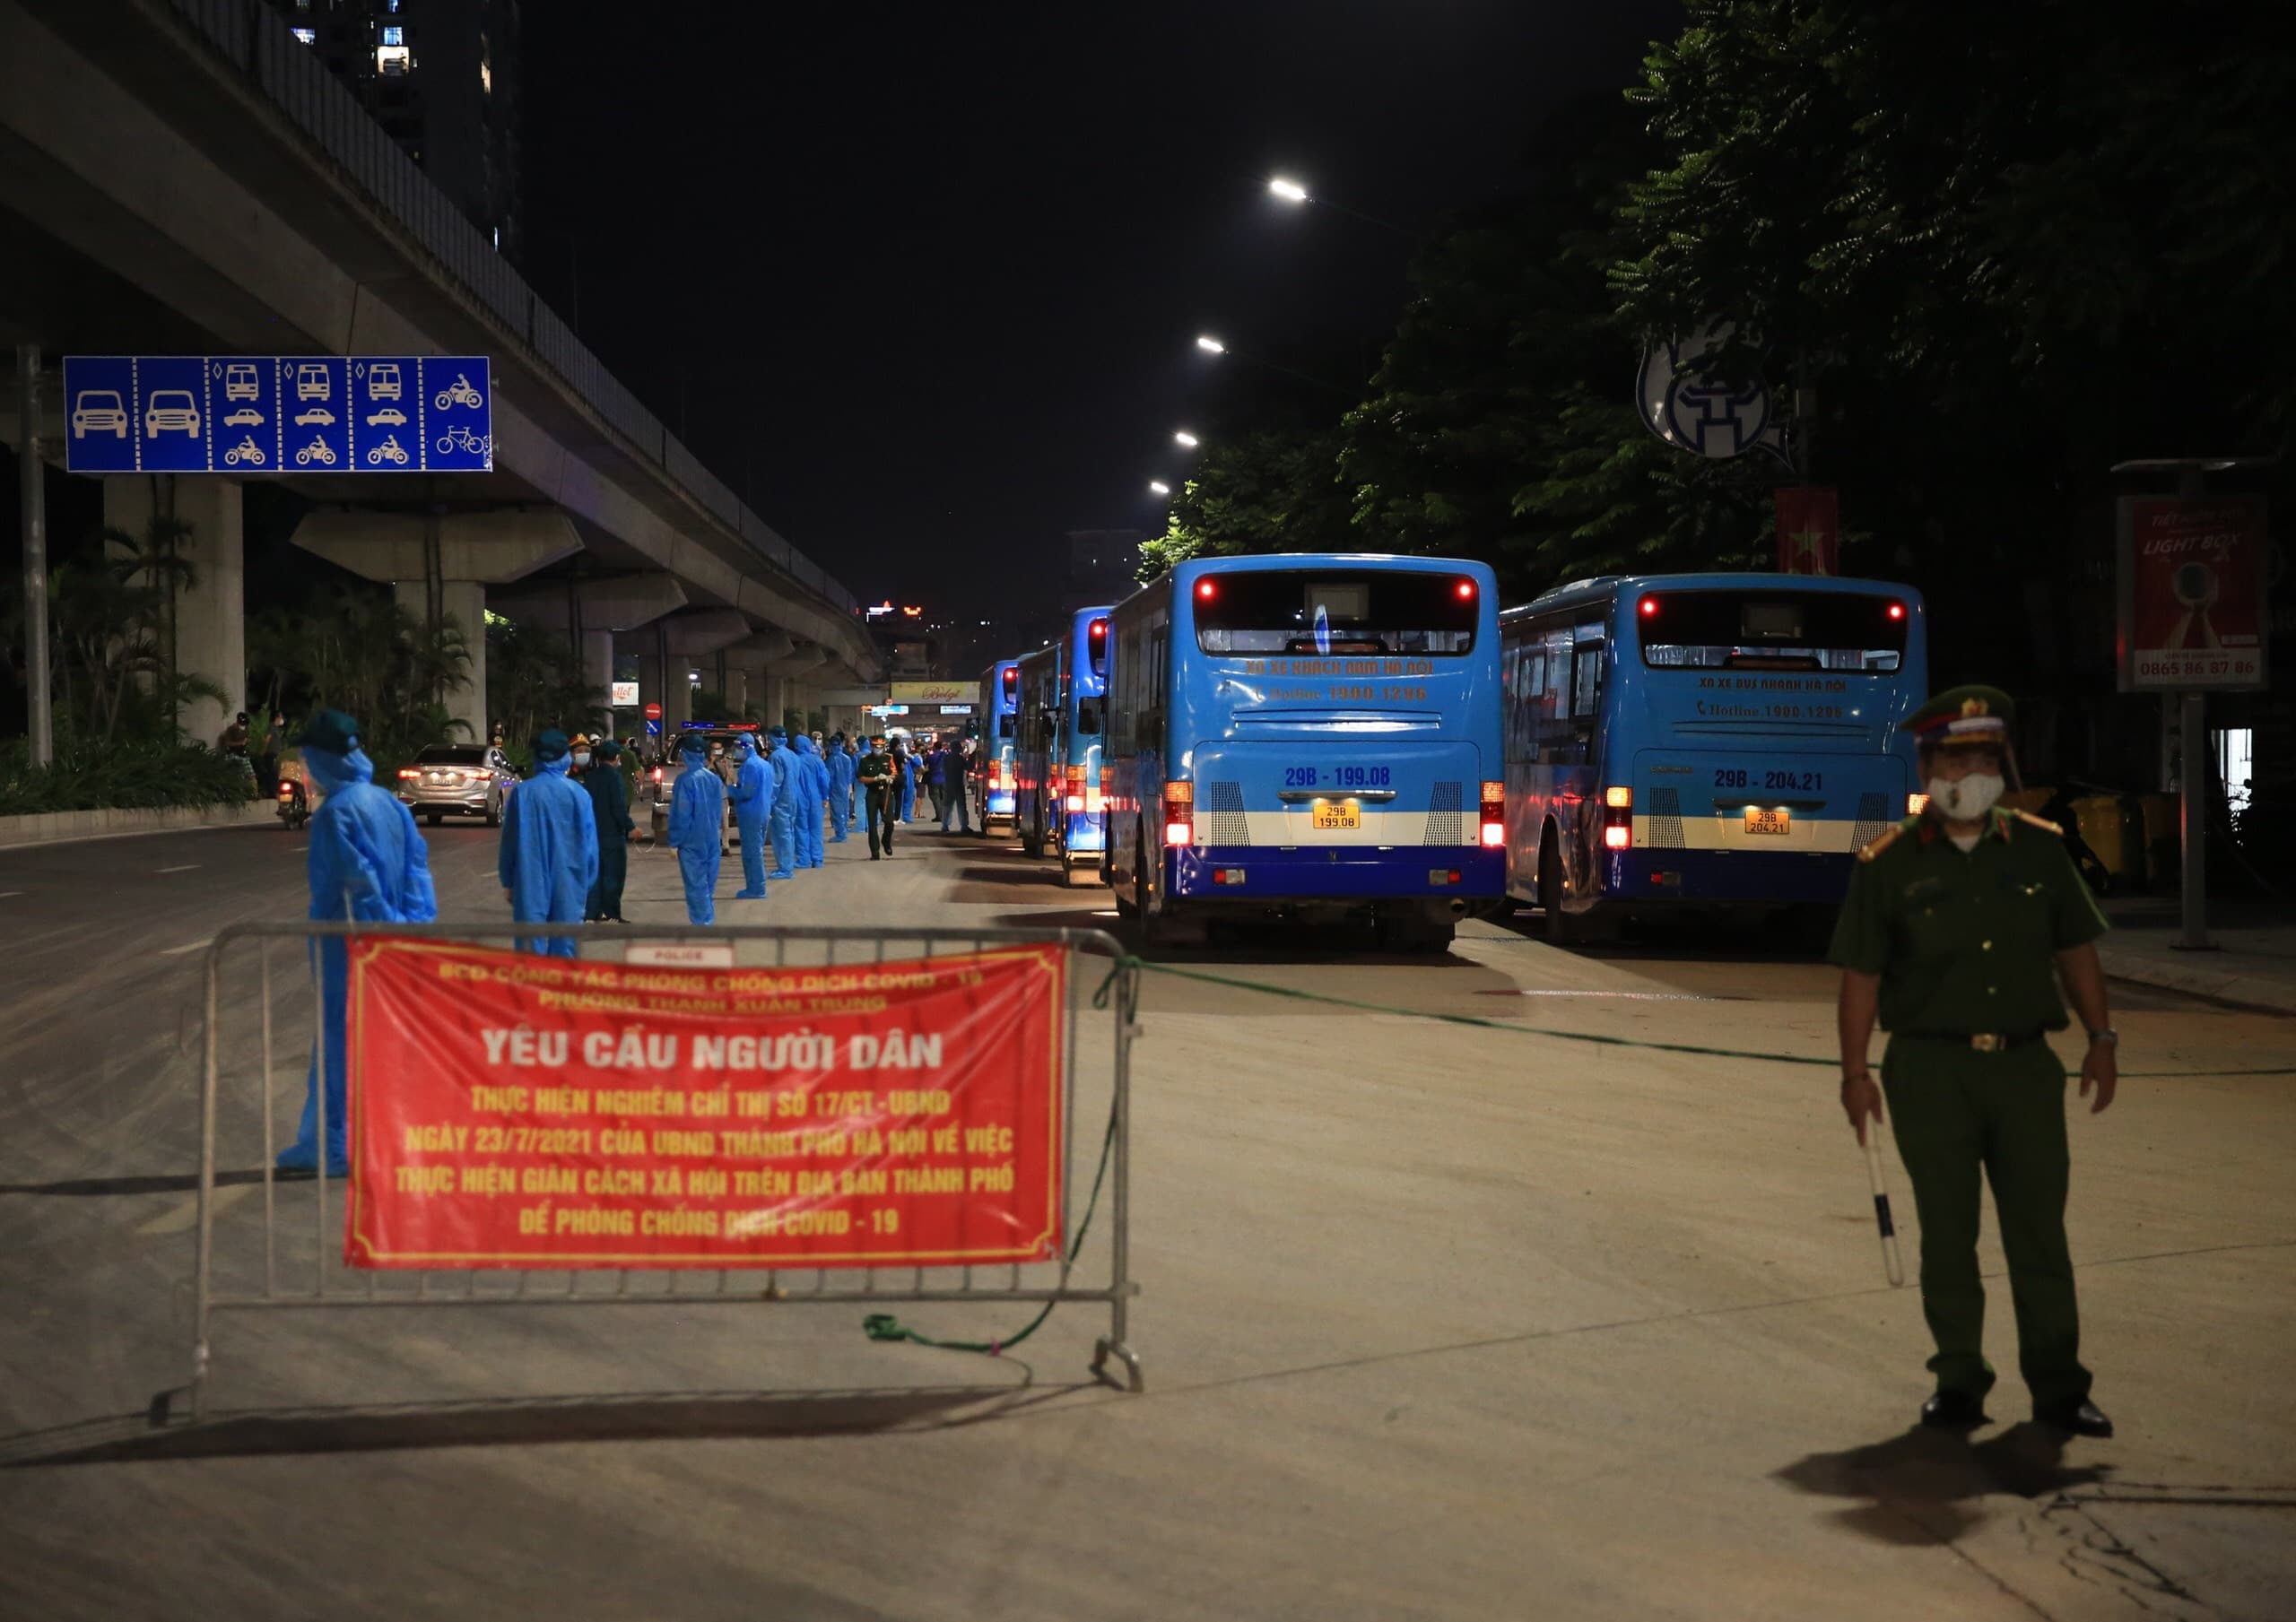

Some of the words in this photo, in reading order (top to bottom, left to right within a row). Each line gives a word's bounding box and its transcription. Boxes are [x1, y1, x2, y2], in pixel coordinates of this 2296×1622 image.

[2143, 536, 2200, 556] LIGHT
[2200, 532, 2242, 551] BOX
[2141, 662, 2180, 675] 0865
[1285, 768, 1317, 786] 29B
[1335, 767, 1390, 786] 199.08
[1715, 768, 1747, 788] 29B
[1765, 771, 1822, 790] 204.21
[1326, 807, 1346, 816] 29B
[1758, 812, 1777, 822] 29B
[1750, 822, 1783, 833] 204.21
[655, 951, 702, 960] POLICE
[571, 966, 617, 987] TÁC
[863, 972, 935, 991] COVID
[649, 994, 726, 1012] THANH
[808, 995, 887, 1012] TRUNG
[481, 1023, 568, 1067] YÊU
[584, 1023, 676, 1069] CẦU
[691, 1028, 835, 1070] NGƯỜI
[849, 1028, 943, 1070] DÂN
[472, 1085, 528, 1117] THỰC
[535, 1085, 588, 1118] HIỆN
[405, 1121, 467, 1151] NGÀY
[474, 1126, 591, 1154] 23/7/2021
[600, 1120, 646, 1155] CỦA
[653, 1130, 715, 1157] UBND
[853, 1124, 883, 1156] HÀ
[965, 1123, 1013, 1158] VIỆC
[396, 1166, 454, 1197] THỰC
[461, 1163, 516, 1198] HIỆN
[585, 1163, 645, 1195] CÁCH
[688, 1167, 727, 1202] HỘI
[734, 1167, 790, 1196] TRÊN
[894, 1163, 964, 1193] THÀNH
[970, 1159, 1015, 1192] PHỐ
[555, 1203, 634, 1236] PHÒNG
[641, 1201, 718, 1236] CHỐNG
[784, 1210, 850, 1236] COVID
[872, 1209, 899, 1235] 19
